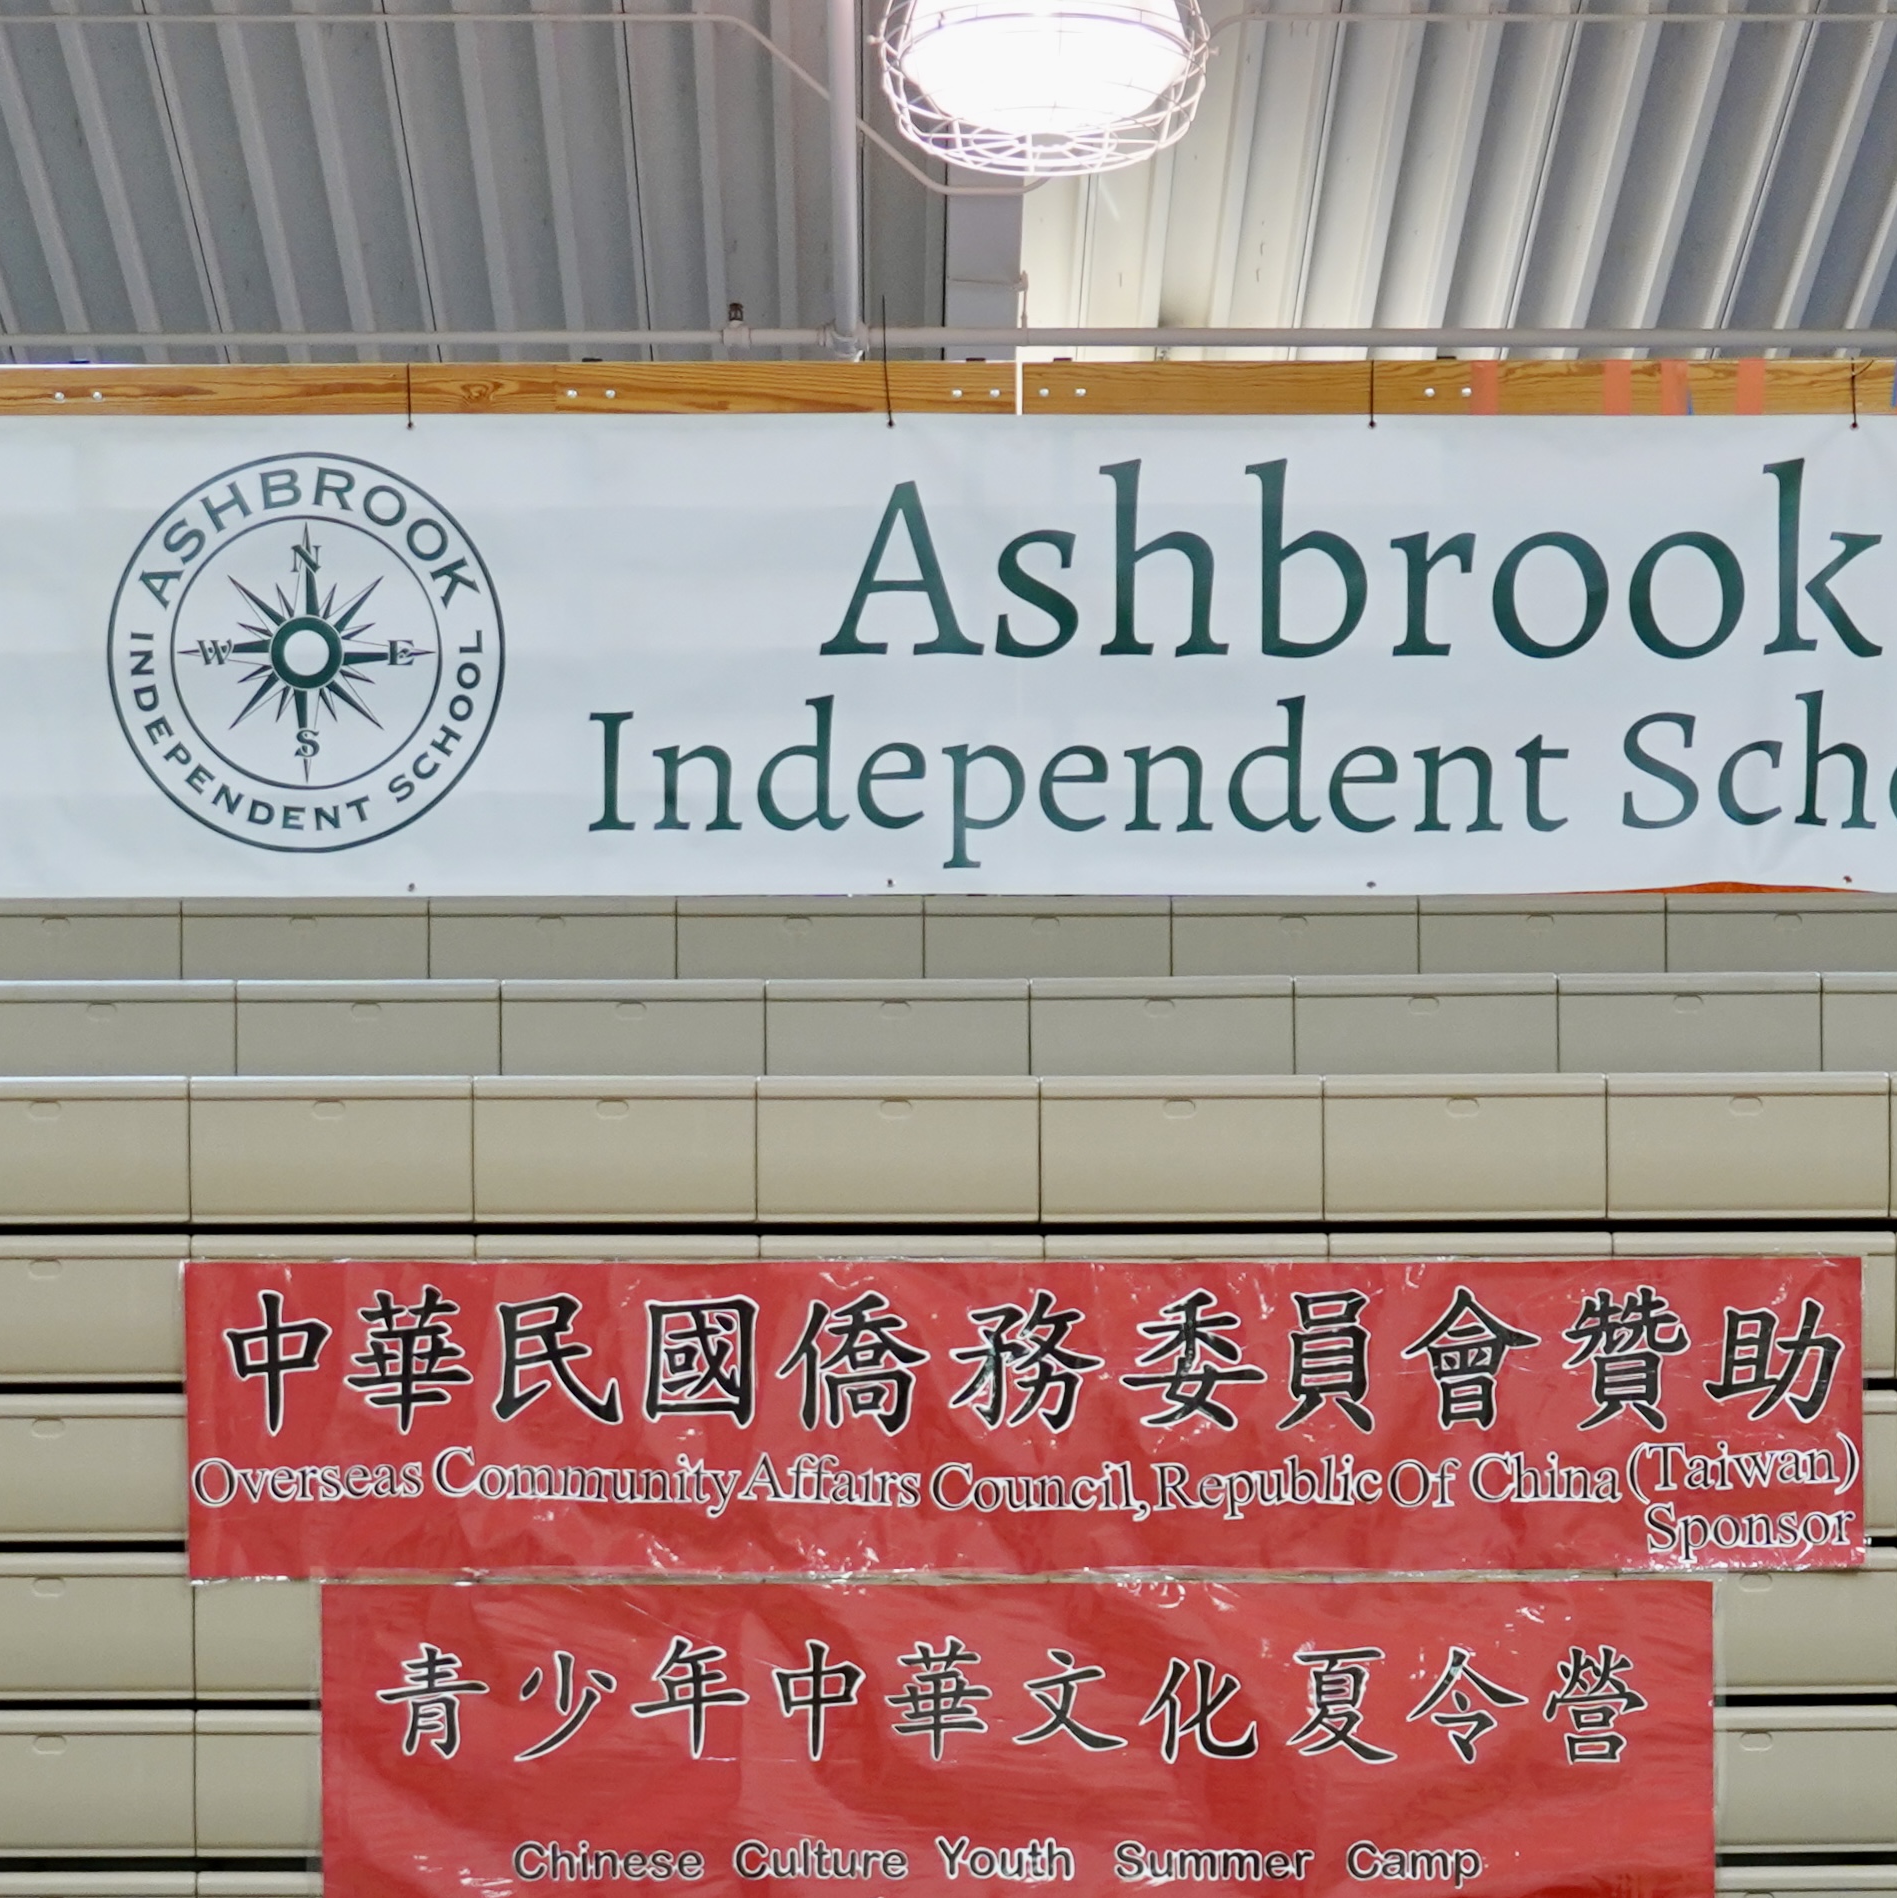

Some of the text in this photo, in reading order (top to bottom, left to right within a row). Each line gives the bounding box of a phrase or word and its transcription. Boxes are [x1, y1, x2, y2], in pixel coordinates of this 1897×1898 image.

[139, 467, 480, 608] ASHBROOK
[820, 458, 1882, 659] Ashbrook
[130, 629, 483, 831] INDEPENDENT SCHOOL
[587, 693, 1570, 870] Independent
[192, 1431, 1859, 1521] Overseas Community Affairs Council, Republic Of China (Taiwan)
[1645, 1501, 1856, 1564] Sponsor
[377, 1638, 1647, 1764] 青少年中華文化夏令營
[513, 1838, 1481, 1888] Chinese Culture Youth Summer Camp
